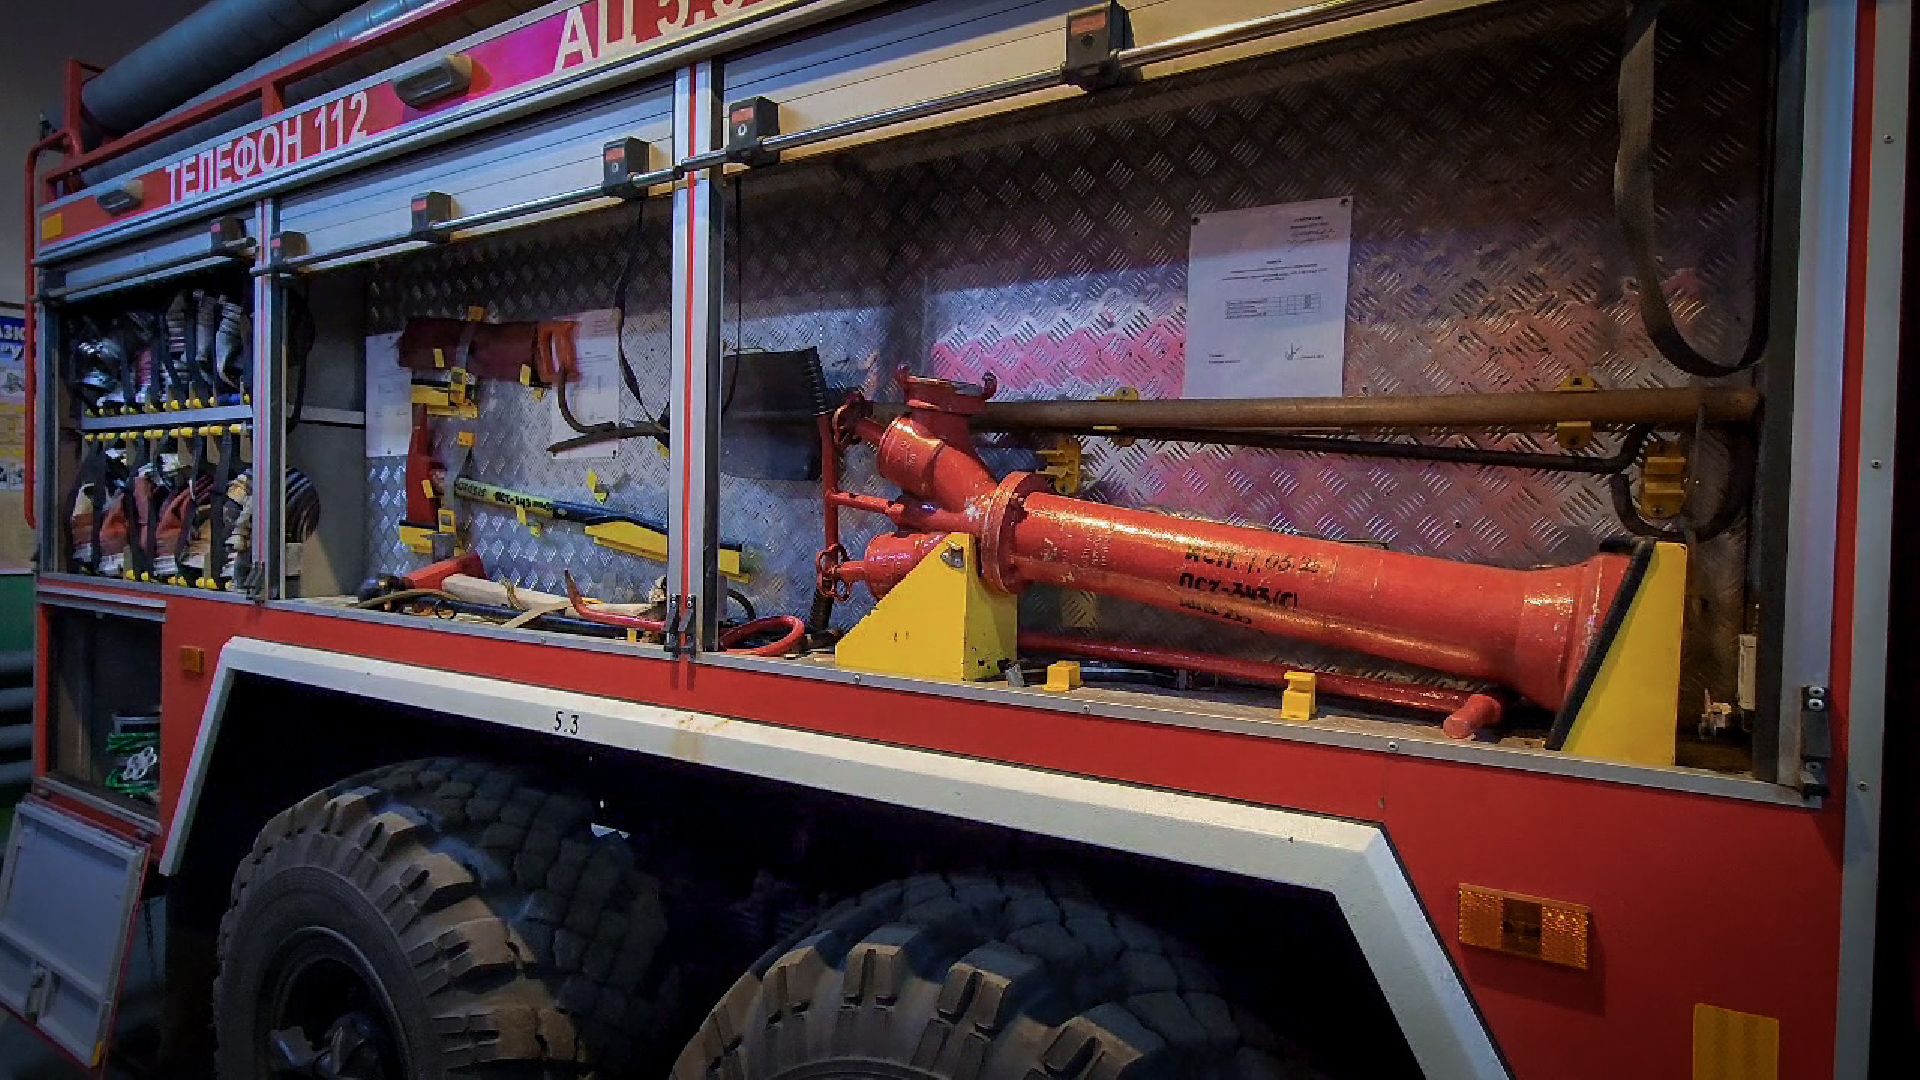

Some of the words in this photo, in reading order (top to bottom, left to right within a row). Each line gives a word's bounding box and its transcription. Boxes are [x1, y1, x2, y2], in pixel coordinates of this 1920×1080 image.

[554, 0, 637, 73] АЦ
[656, 0, 743, 37] 5.
[165, 115, 301, 205] ТЕЛЕФОН
[314, 91, 368, 154] 112
[553, 710, 580, 736] 5.3
